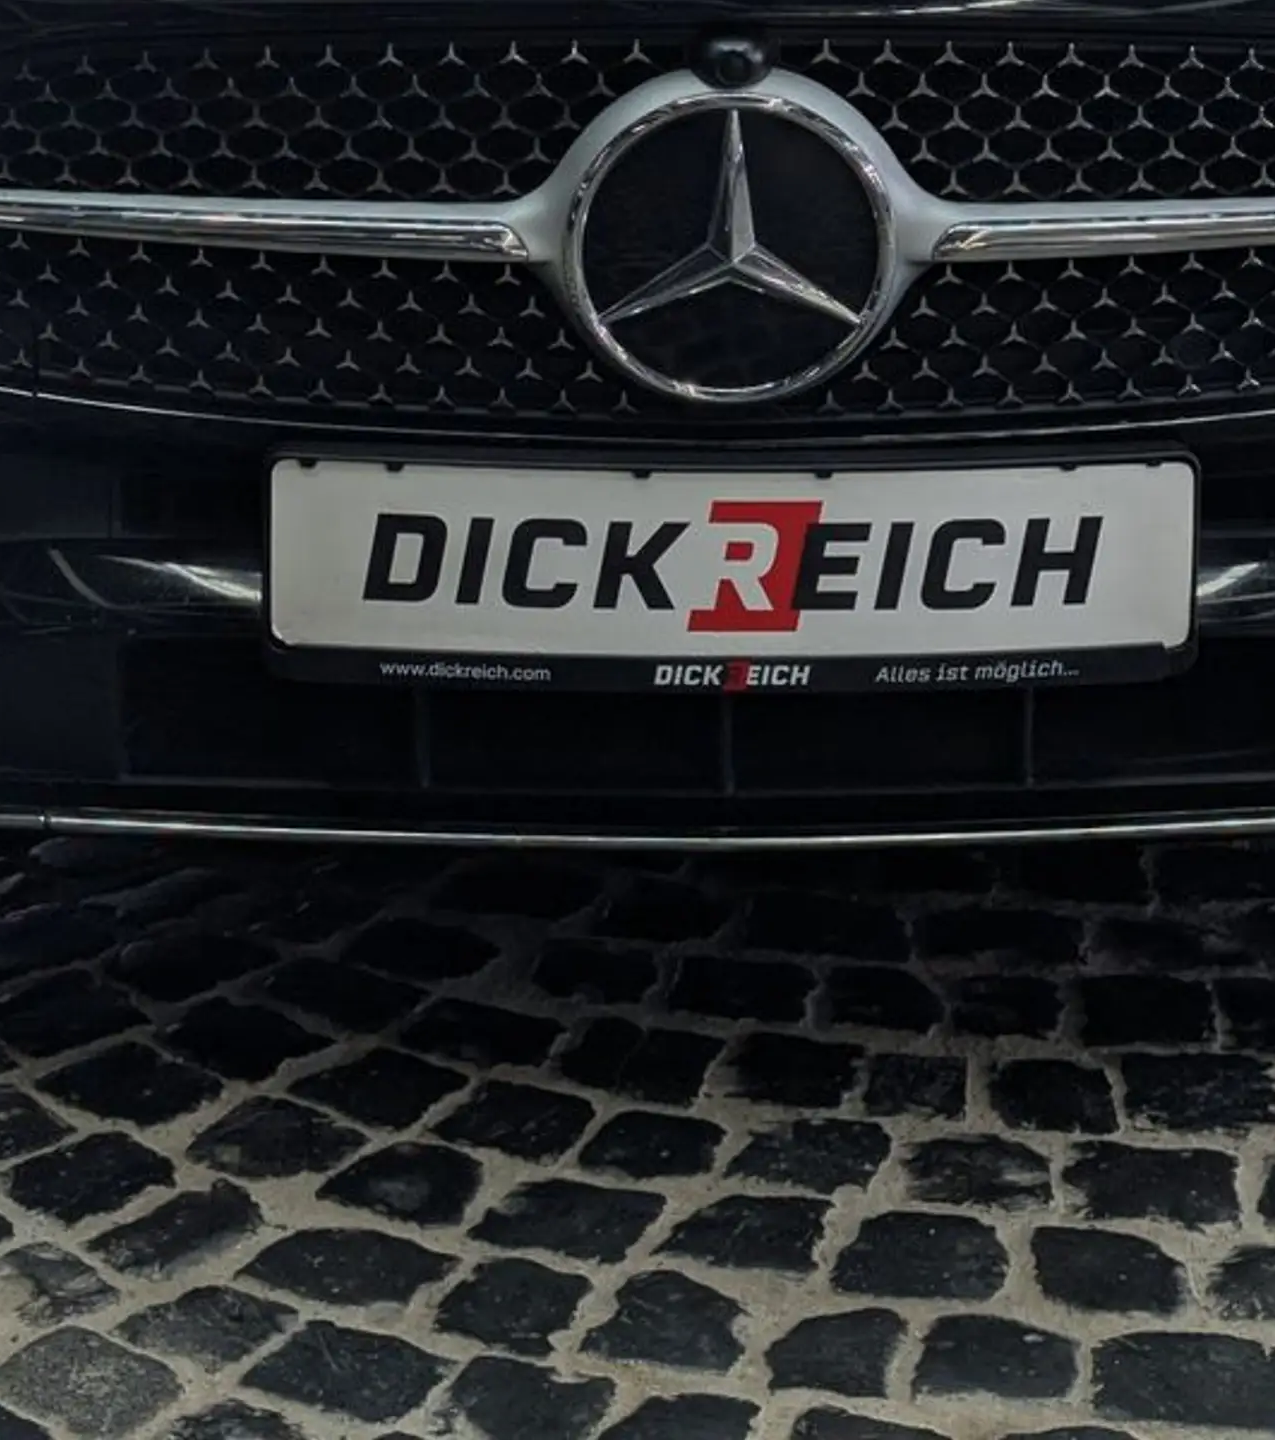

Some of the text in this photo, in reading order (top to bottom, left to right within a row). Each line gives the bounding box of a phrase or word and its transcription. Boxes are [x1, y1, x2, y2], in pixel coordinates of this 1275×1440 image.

[362, 506, 1104, 624] DICKREICH
[380, 662, 552, 682] www.dickreich.com
[876, 667, 931, 683] Alles
[936, 664, 970, 681] ist
